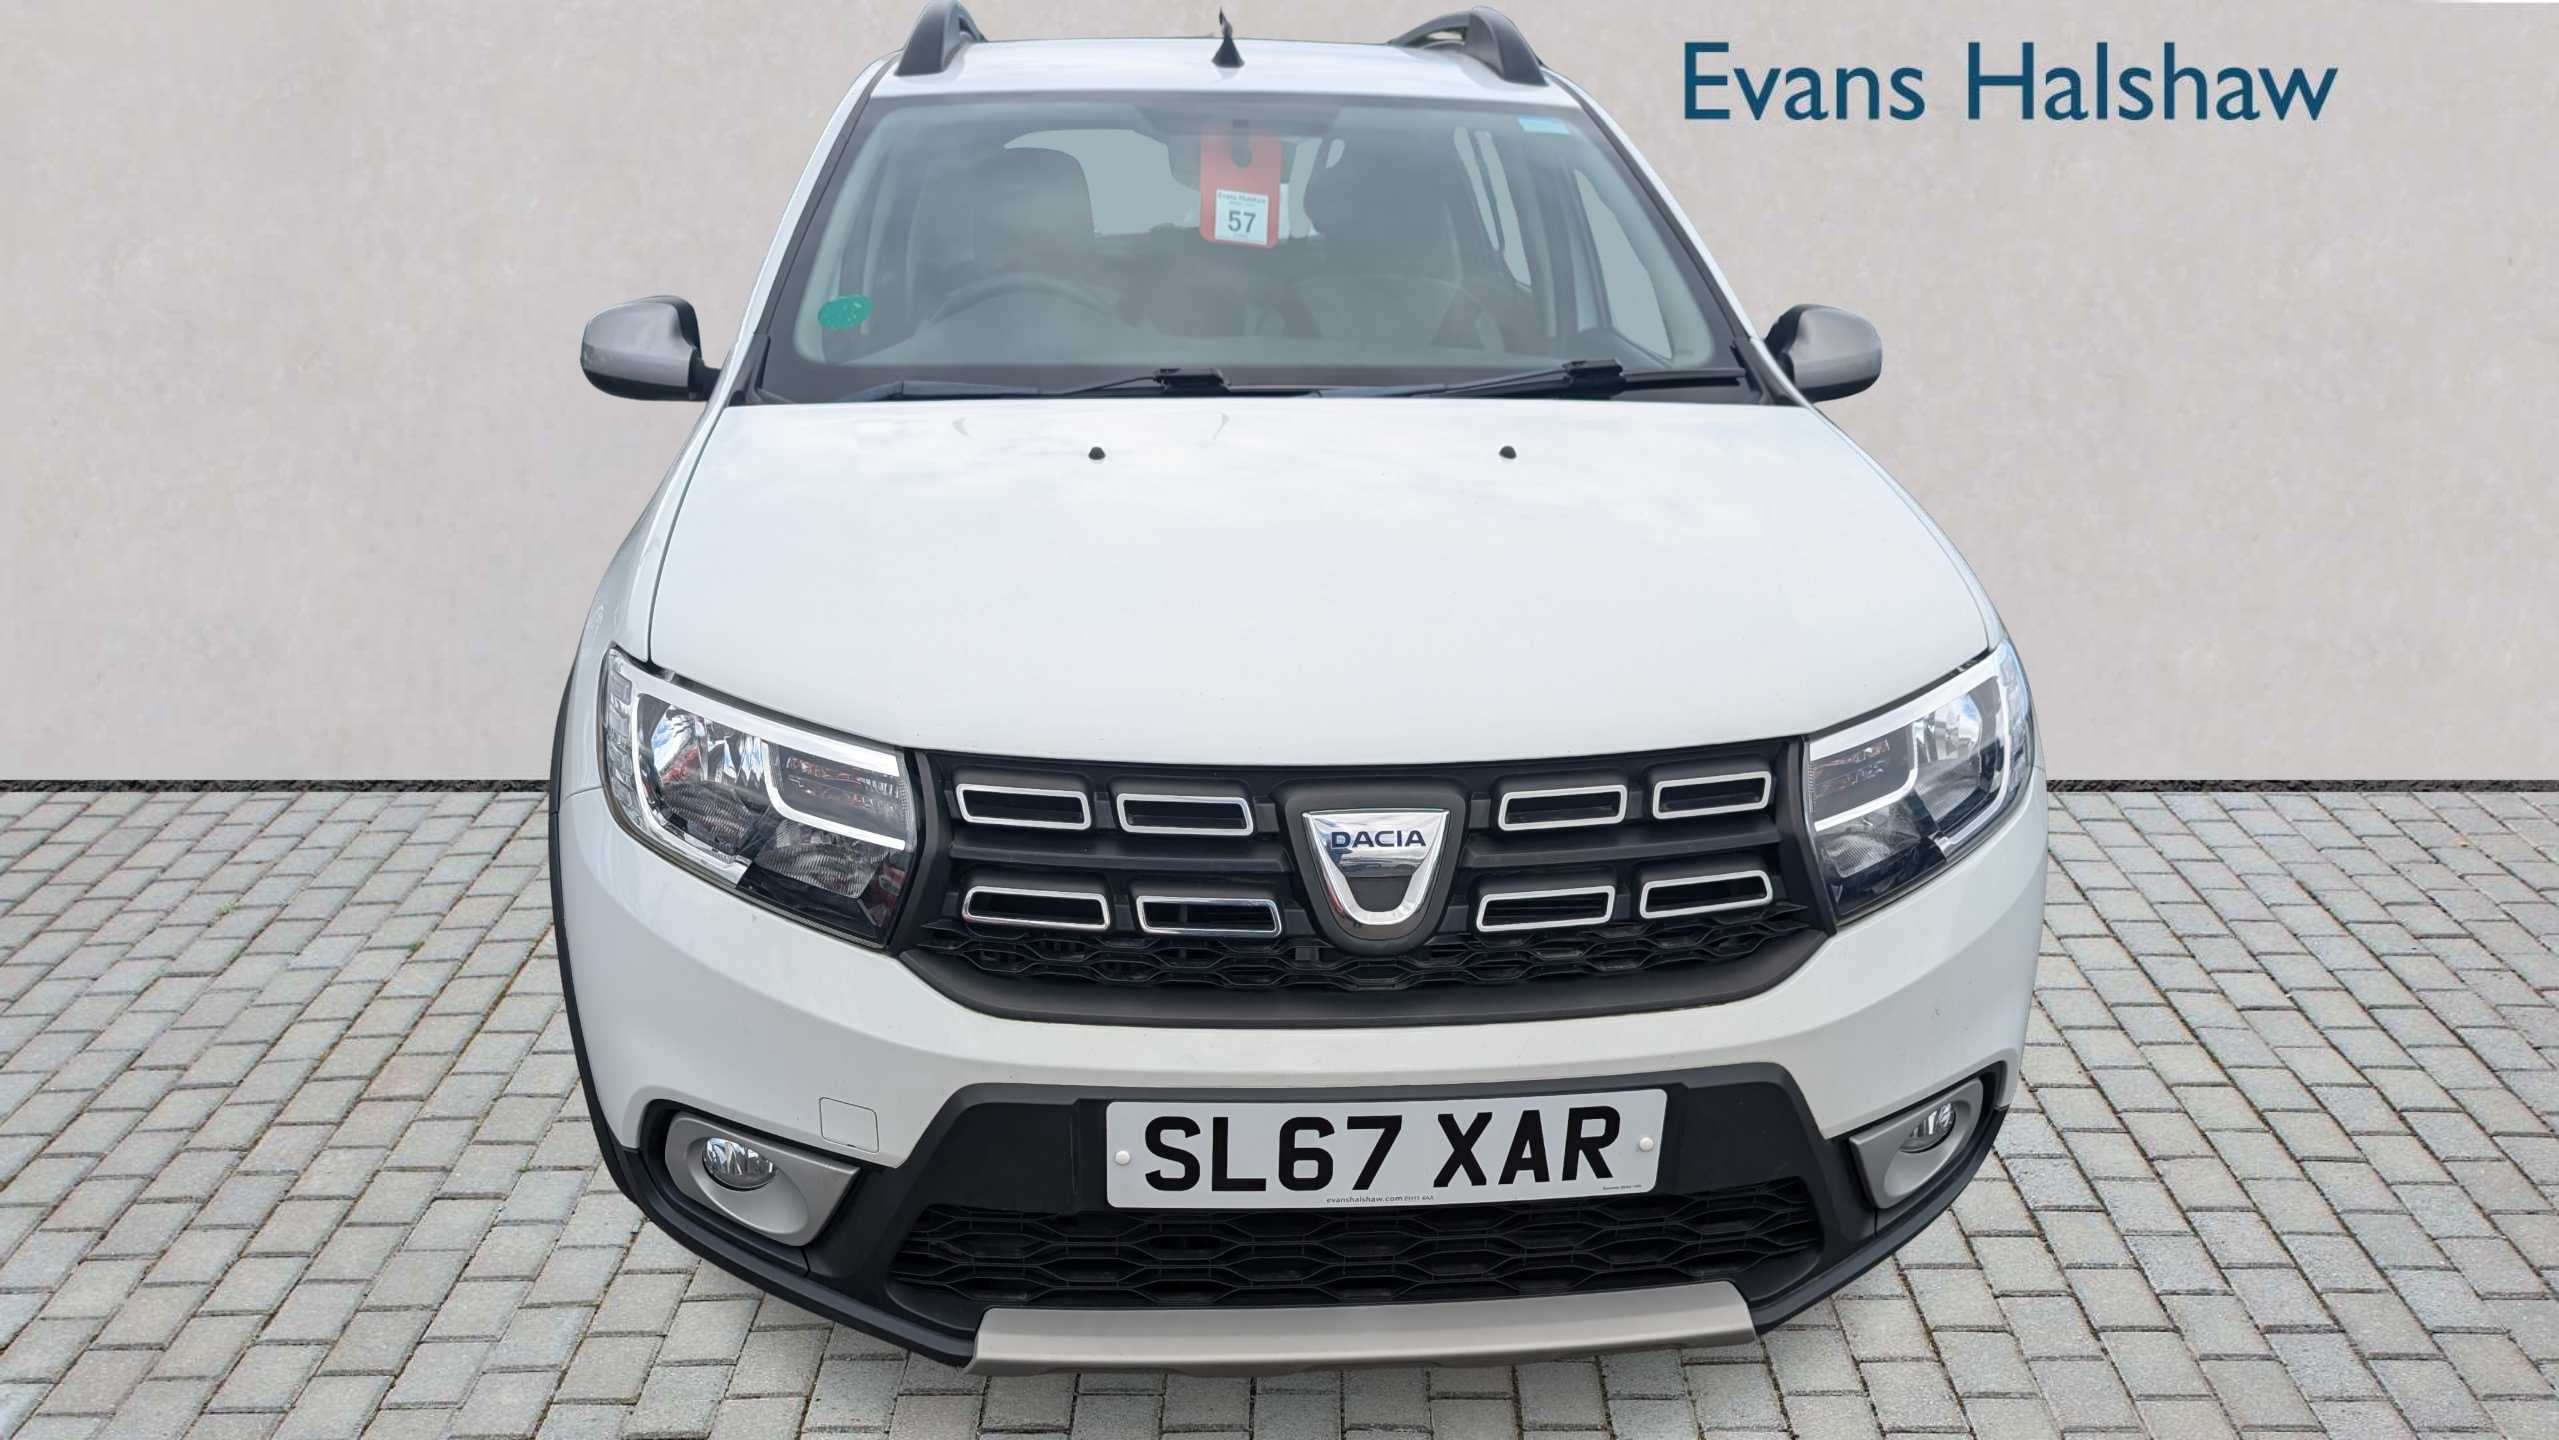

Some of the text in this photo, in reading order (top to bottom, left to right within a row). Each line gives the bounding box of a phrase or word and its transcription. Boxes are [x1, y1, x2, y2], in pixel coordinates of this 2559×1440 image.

[1227, 209, 1257, 233] 57
[1331, 830, 1426, 848] DACIA
[1144, 1105, 1621, 1192] SL67 XAR
